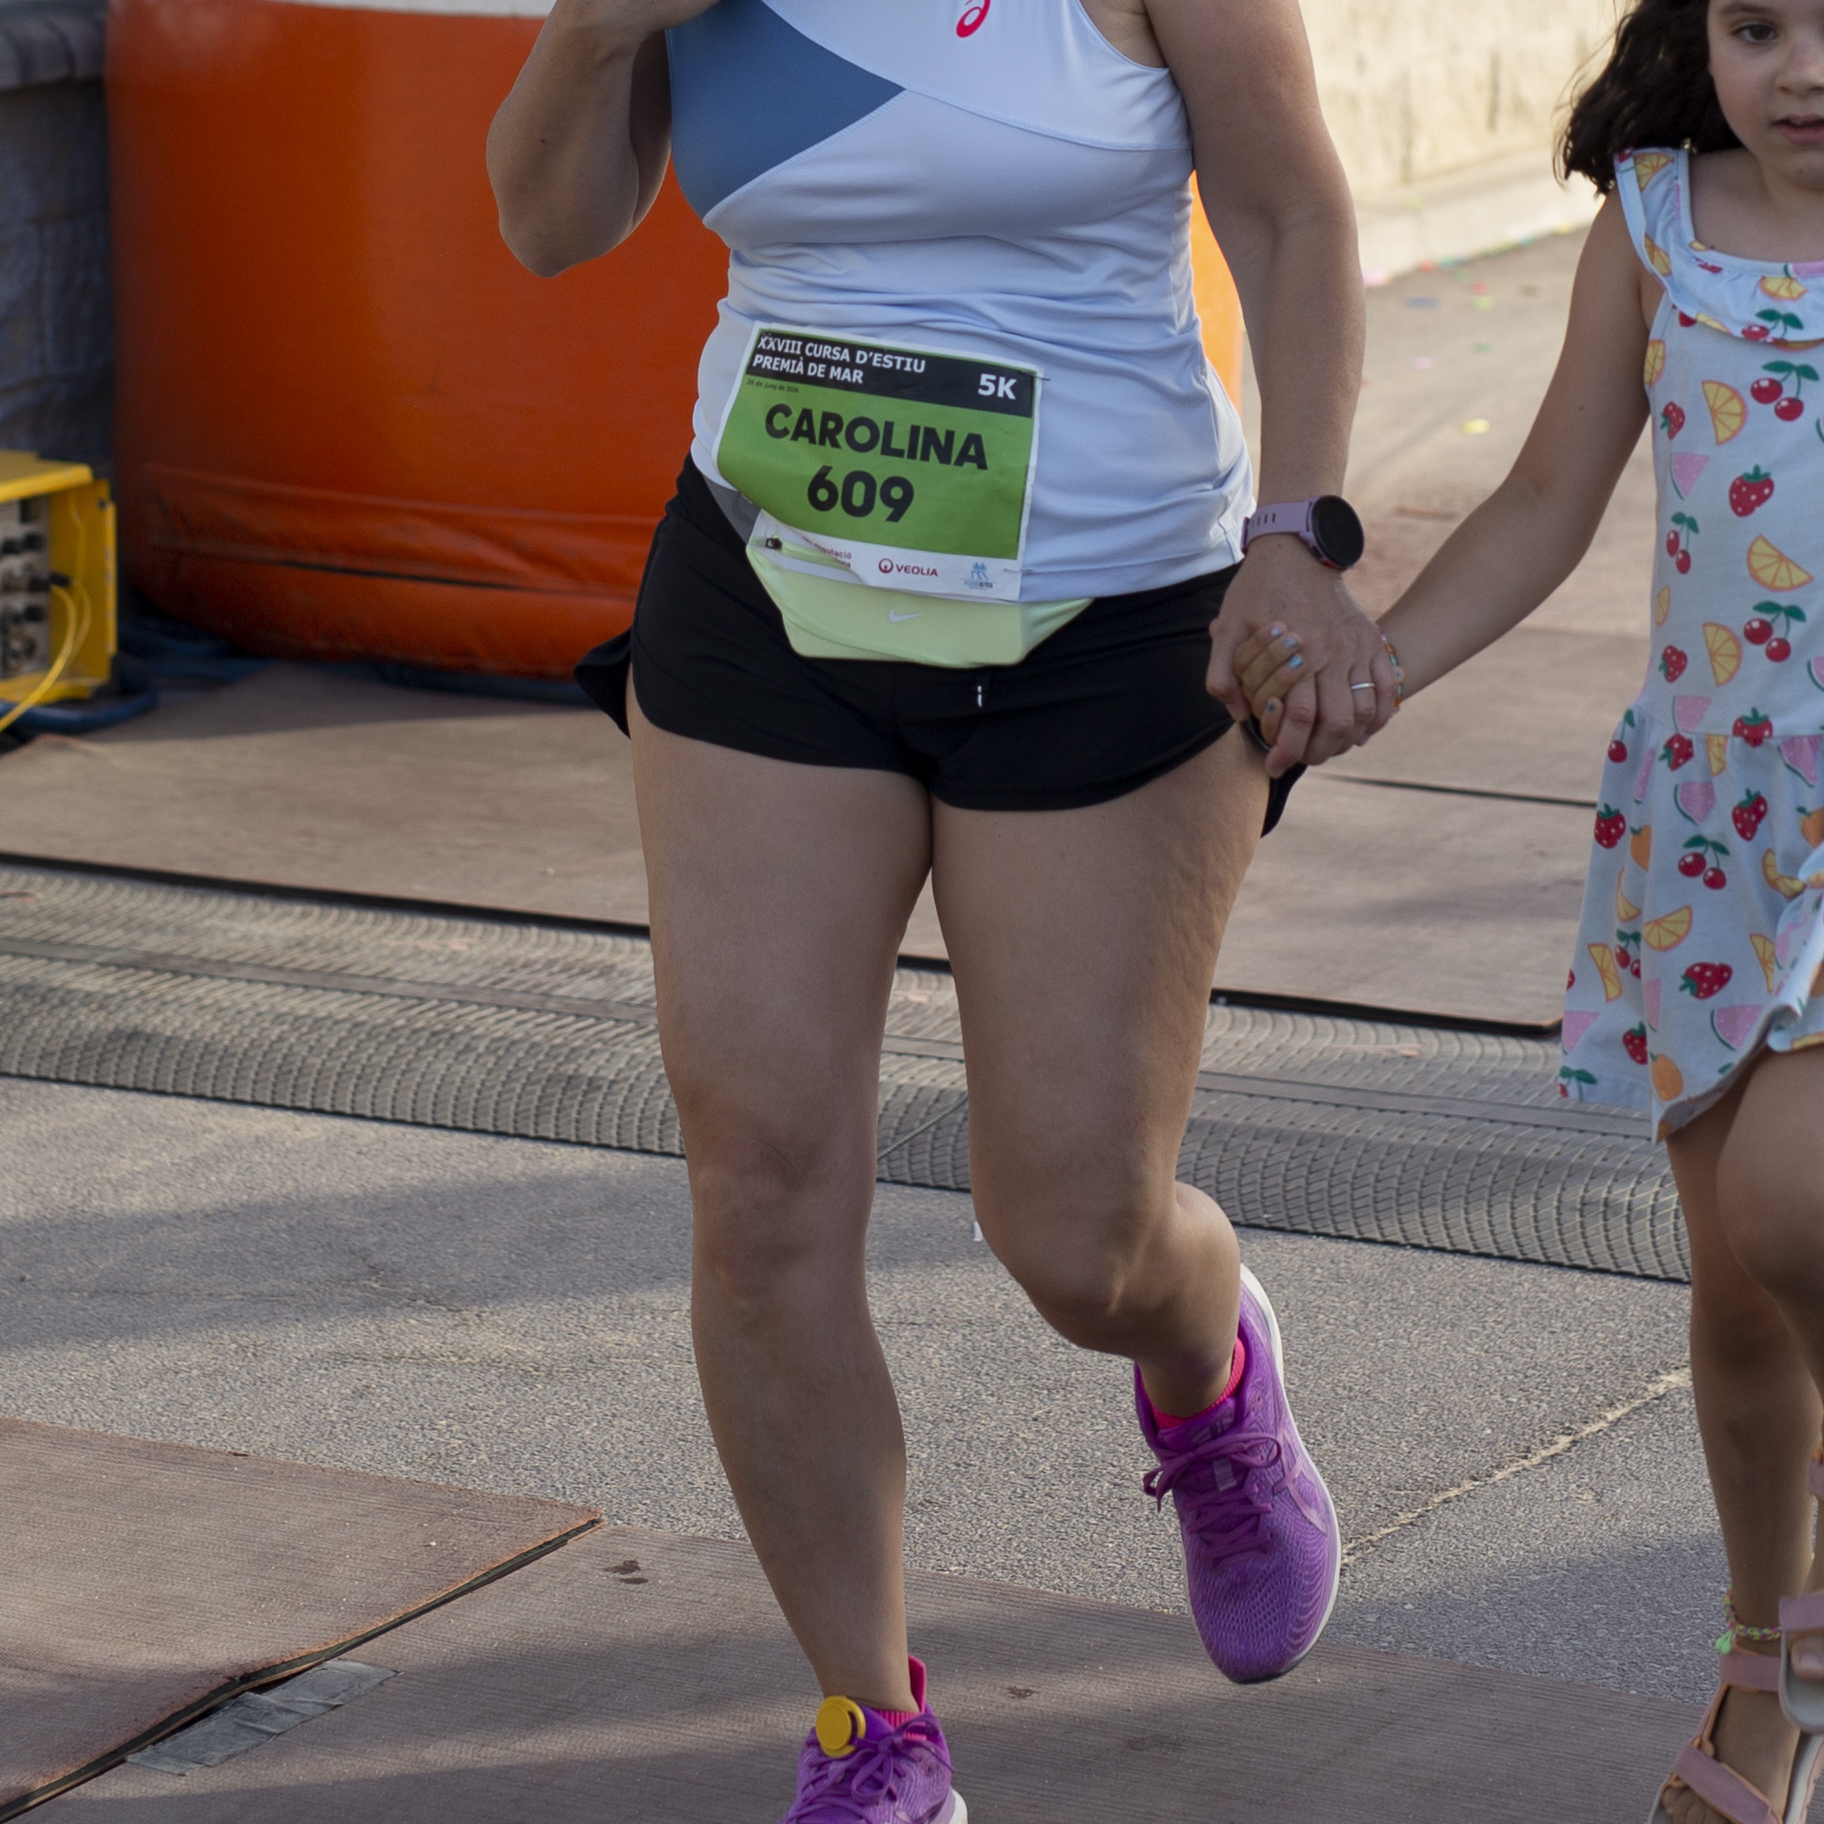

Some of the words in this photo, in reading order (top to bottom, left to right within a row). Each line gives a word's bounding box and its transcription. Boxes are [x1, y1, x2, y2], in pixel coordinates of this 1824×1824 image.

[758, 335, 802, 355] XXVIII
[805, 342, 850, 362] CURSA
[752, 354, 804, 374] PREMIÀ
[807, 362, 827, 377] DE
[829, 366, 863, 384] MAR
[977, 373, 1017, 400] 5K
[764, 403, 988, 470] CAROLINA
[807, 465, 915, 522] 609
[895, 563, 938, 577] VEOLIA
